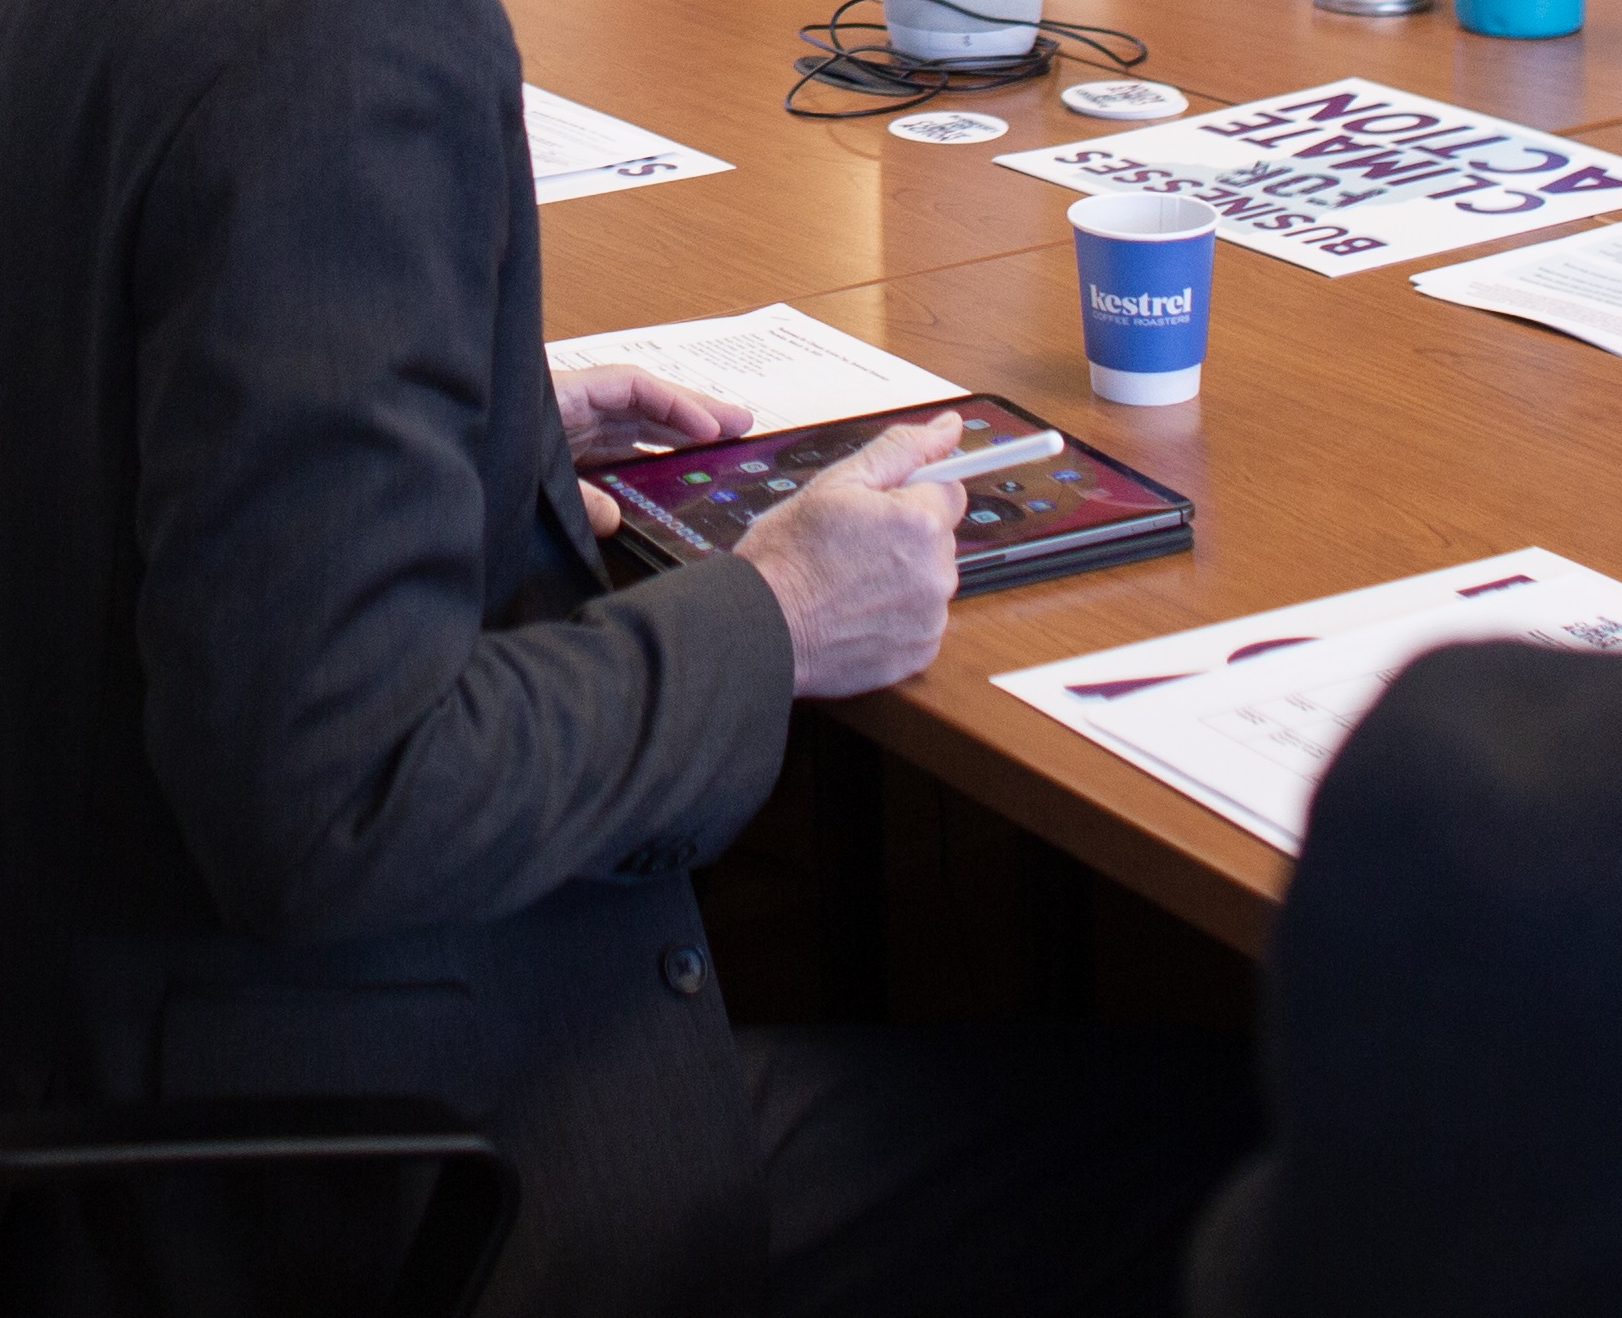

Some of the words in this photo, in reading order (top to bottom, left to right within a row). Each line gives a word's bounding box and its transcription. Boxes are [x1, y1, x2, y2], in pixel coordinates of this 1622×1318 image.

[1199, 110, 1547, 215] CLIMATE
[1214, 160, 1388, 208] FOR
[1054, 149, 1389, 257] BUSINESSES
[1090, 284, 1192, 316] kestrel
[1092, 310, 1129, 326] COFFEE
[1134, 315, 1190, 327] ROASTERS
